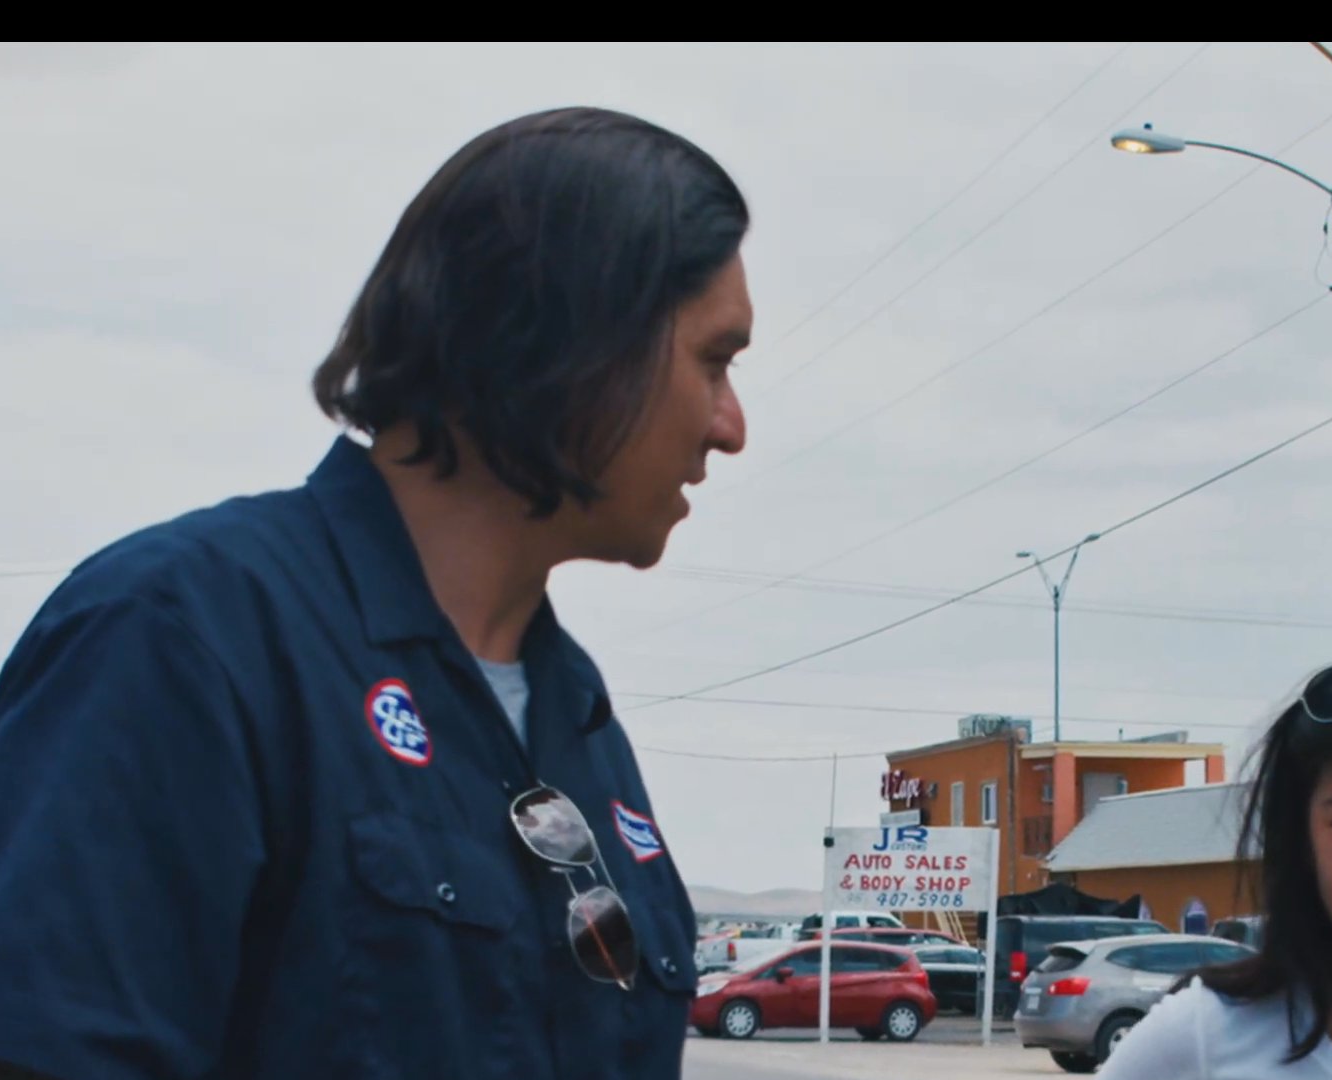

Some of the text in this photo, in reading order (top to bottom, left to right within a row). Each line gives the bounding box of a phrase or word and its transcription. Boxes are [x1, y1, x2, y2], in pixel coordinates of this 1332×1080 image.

[873, 824, 928, 850] JR
[844, 854, 967, 871] AUTO SALES
[840, 875, 971, 891] & BODY SHOP
[876, 893, 963, 907] 407-5908
